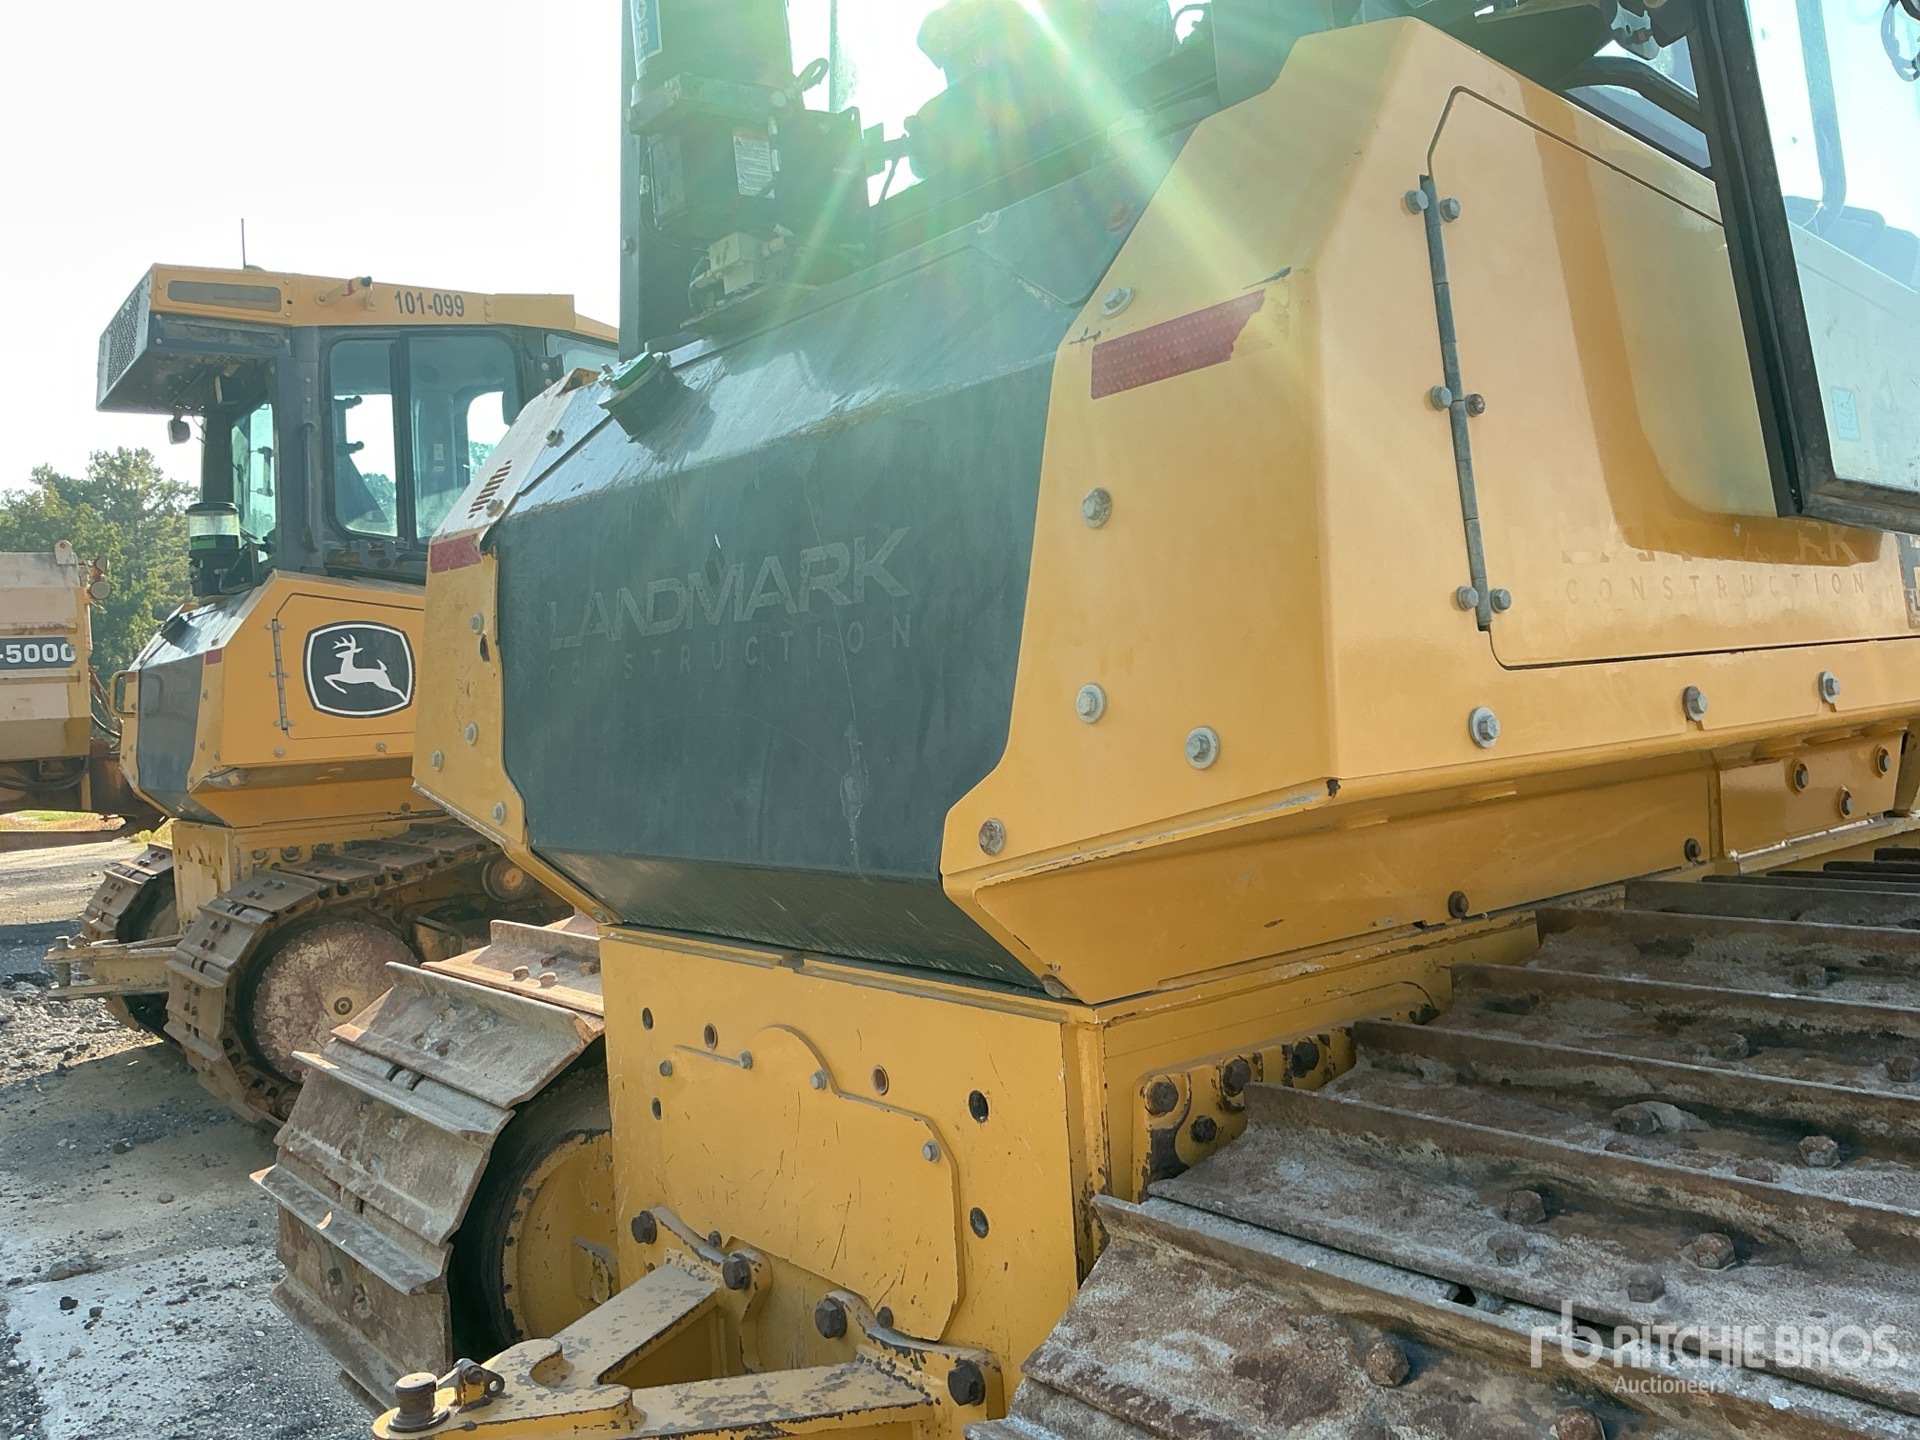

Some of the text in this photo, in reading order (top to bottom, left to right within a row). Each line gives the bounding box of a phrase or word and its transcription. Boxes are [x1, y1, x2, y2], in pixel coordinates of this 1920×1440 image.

[394, 290, 465, 318] 101-099
[548, 525, 911, 651] LANDMARK
[1565, 571, 1867, 605] CONSTRUCTION
[546, 613, 912, 689] COSTRUCTION
